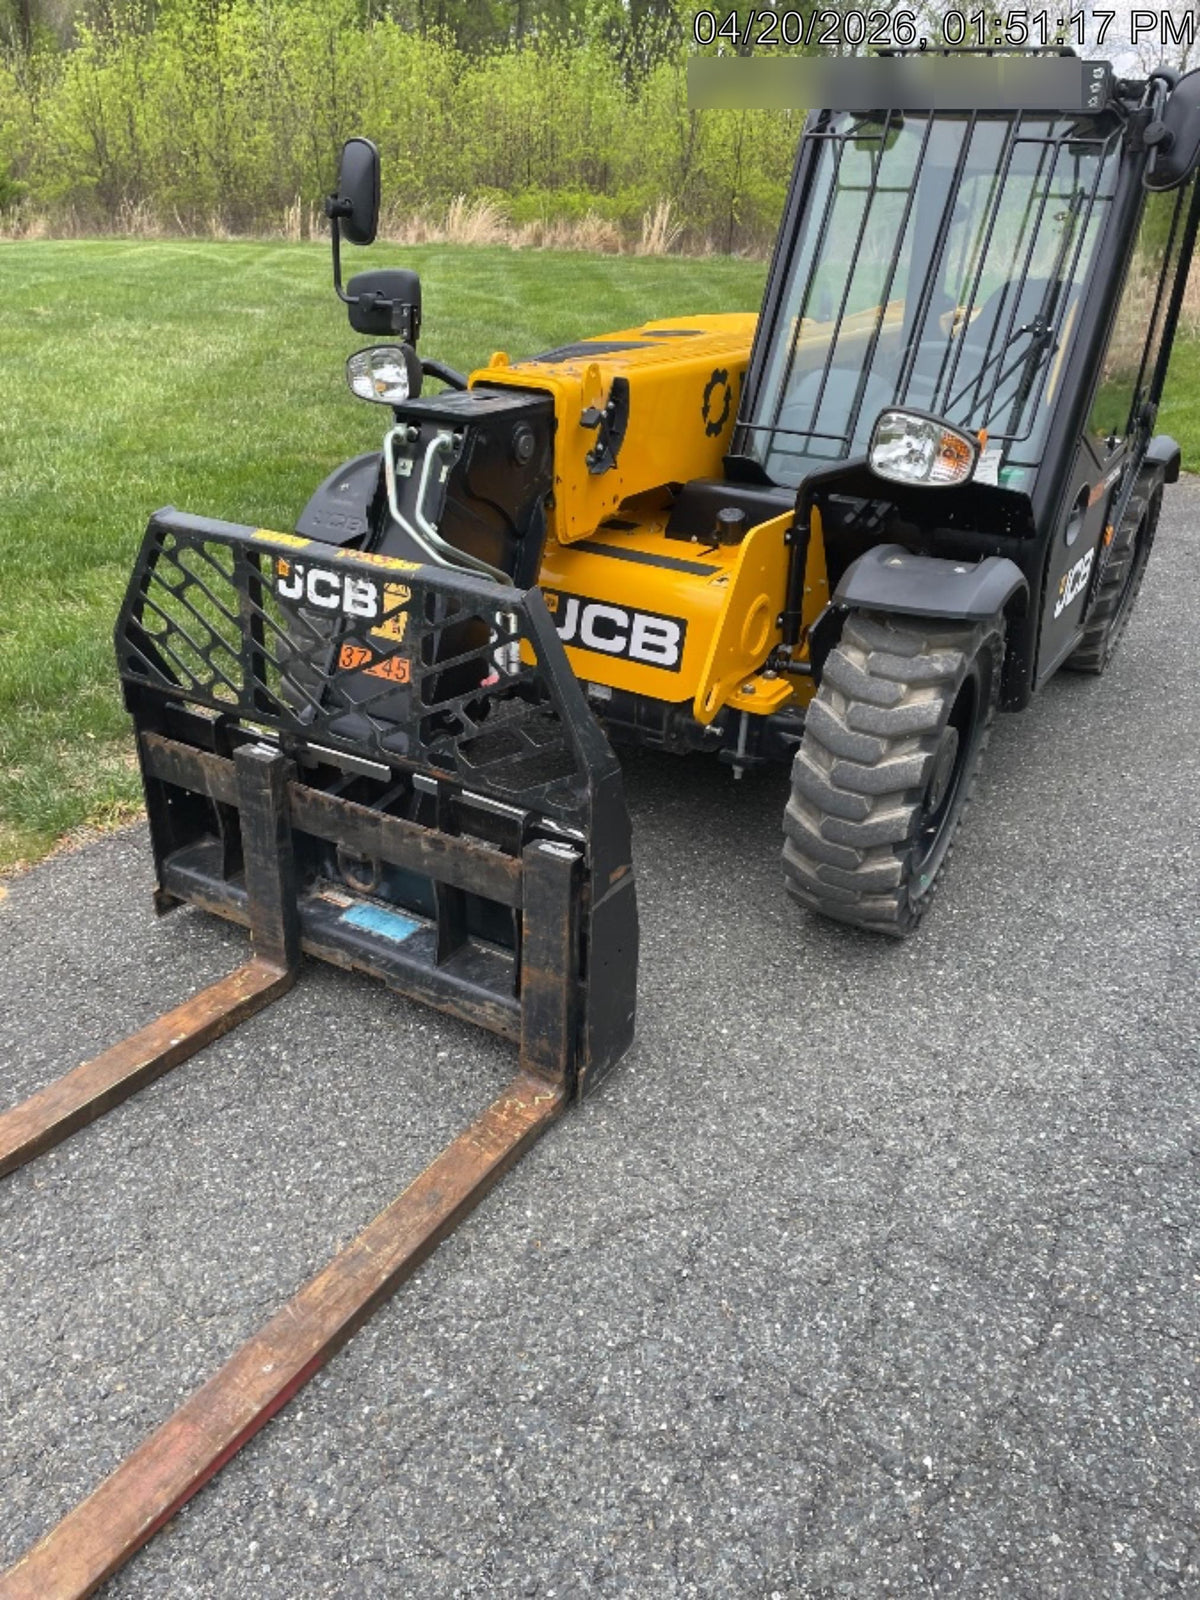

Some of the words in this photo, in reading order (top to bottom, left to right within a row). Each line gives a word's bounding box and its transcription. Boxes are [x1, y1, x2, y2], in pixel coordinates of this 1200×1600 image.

[277, 564, 378, 618] JCB
[1053, 547, 1095, 619] JCB
[556, 598, 681, 666] JCB
[341, 645, 408, 683] 3745
